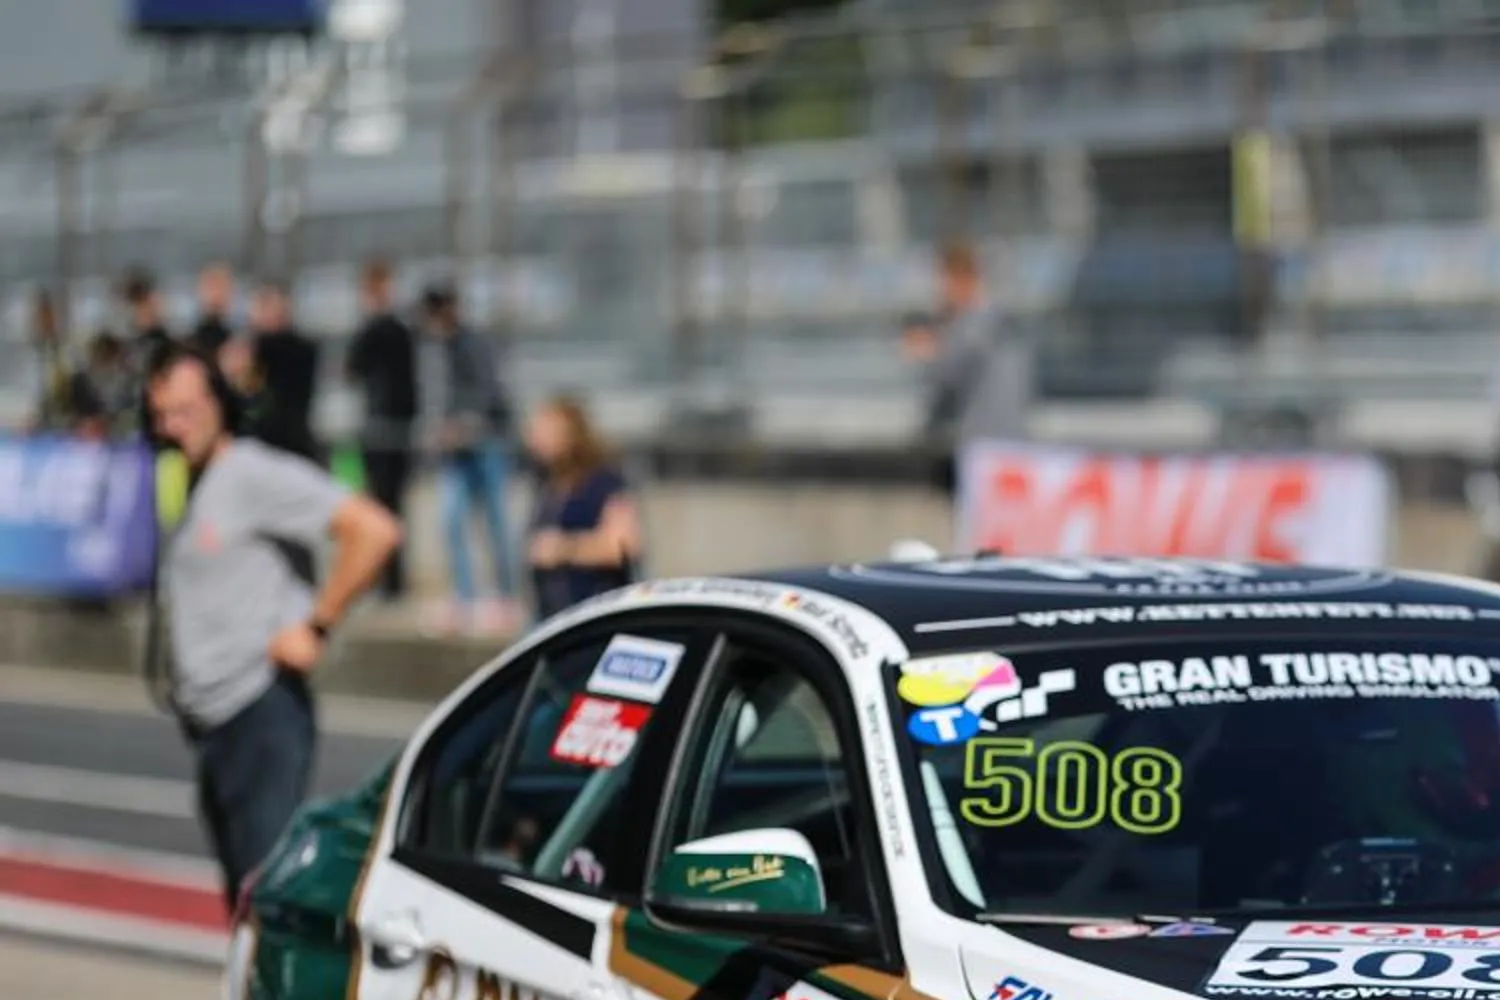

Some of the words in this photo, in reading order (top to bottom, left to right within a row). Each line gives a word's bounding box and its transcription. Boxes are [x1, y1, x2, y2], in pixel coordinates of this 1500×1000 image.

[1103, 655, 1252, 698] GRAN
[1259, 652, 1492, 686] TURISMO
[1116, 692, 1174, 711] THE
[960, 737, 1184, 834] 508
